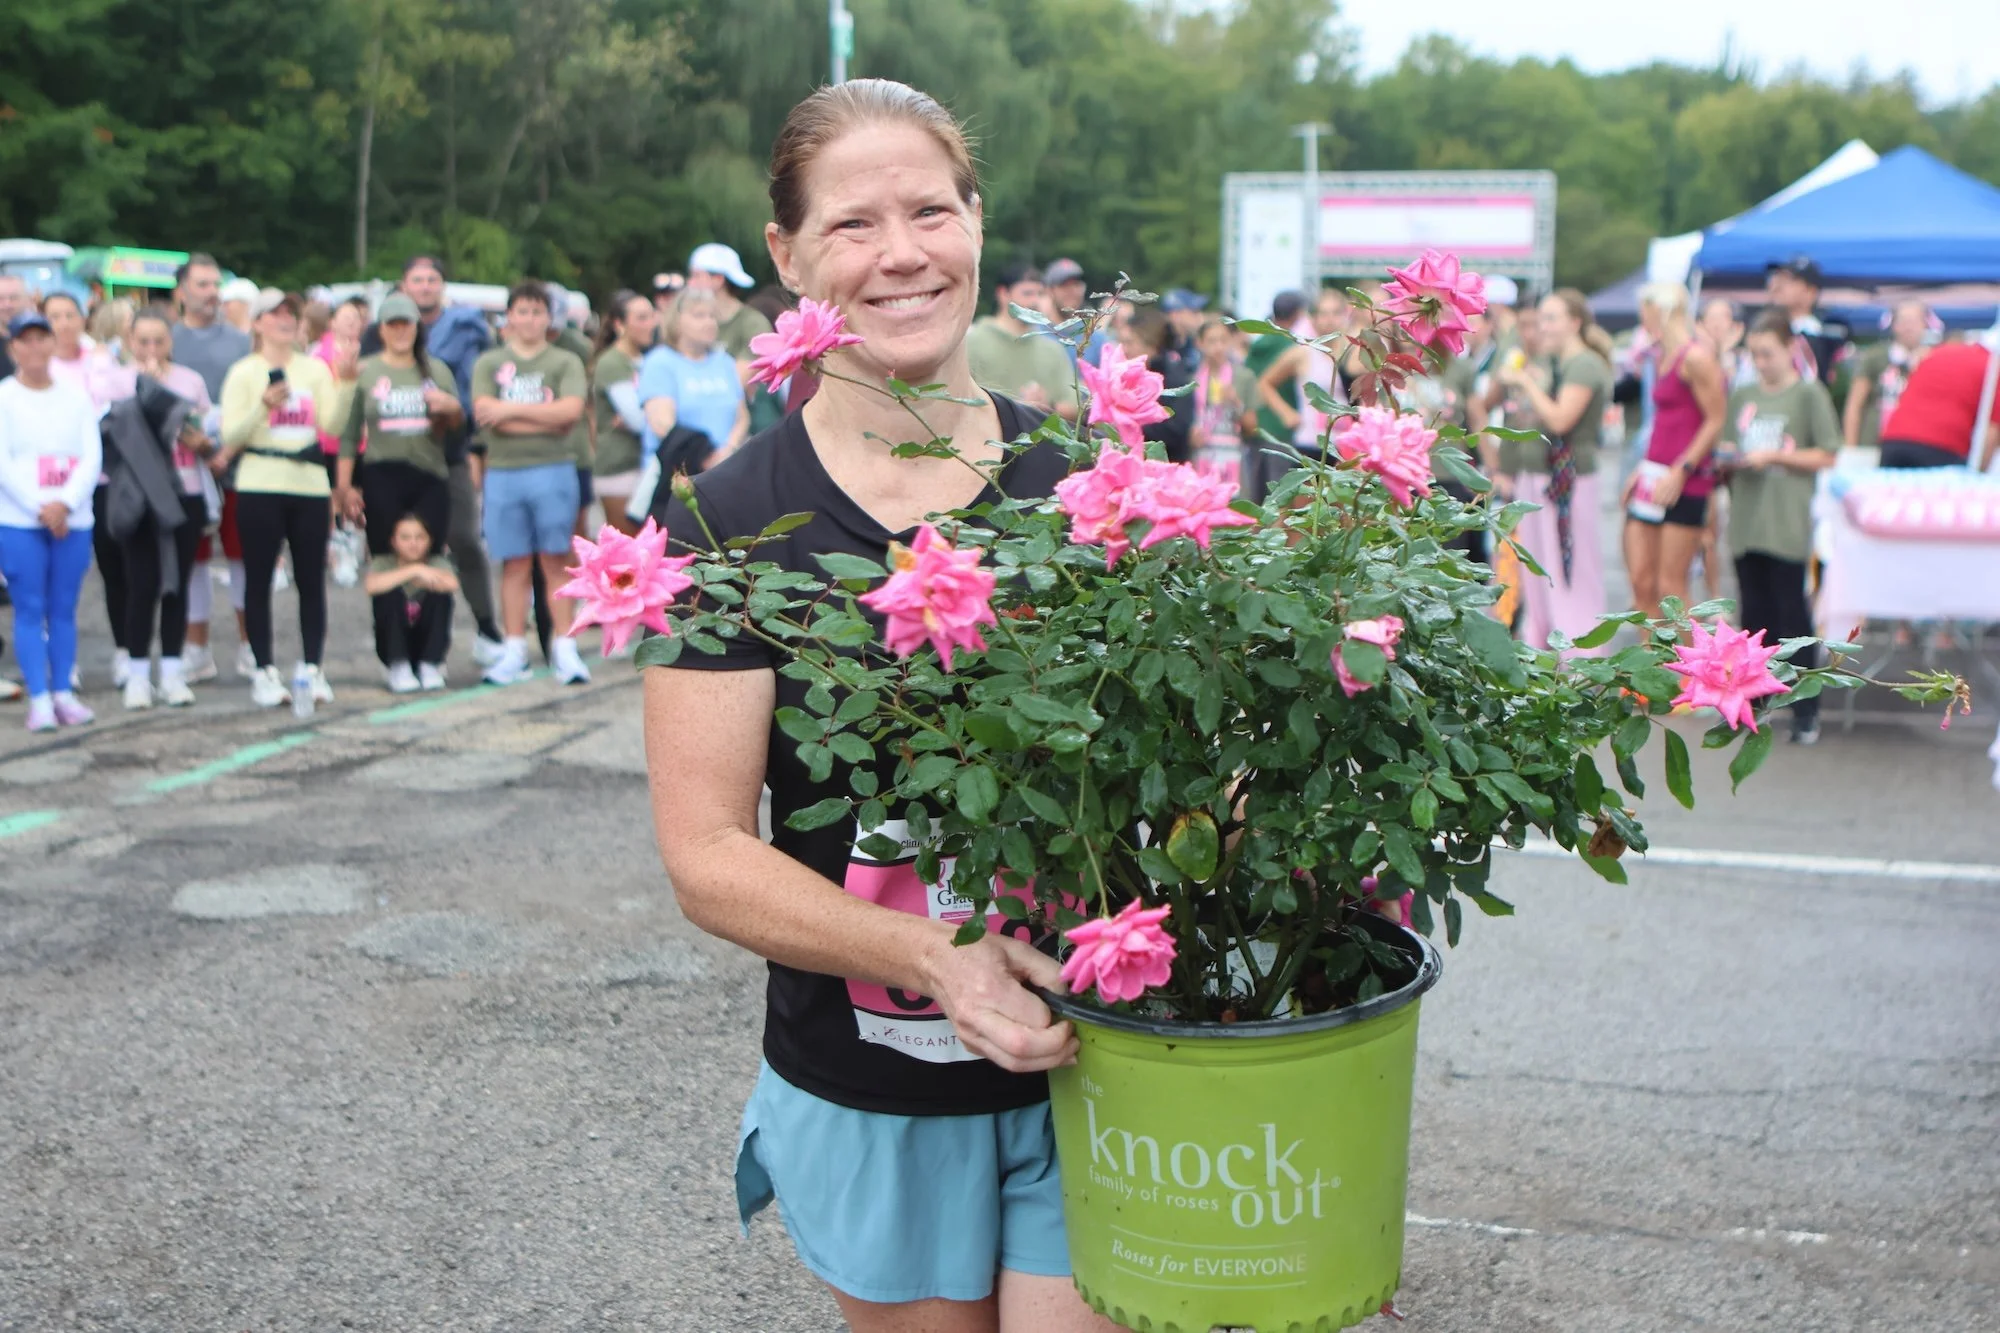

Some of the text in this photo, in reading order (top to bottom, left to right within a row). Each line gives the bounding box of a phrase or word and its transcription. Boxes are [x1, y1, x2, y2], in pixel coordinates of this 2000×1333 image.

[1081, 1073, 1104, 1097] the
[1082, 1096, 1304, 1191] knock
[1088, 1164, 1219, 1212] family of roses
[1111, 1238, 1308, 1277] Roses for EVERYONE
